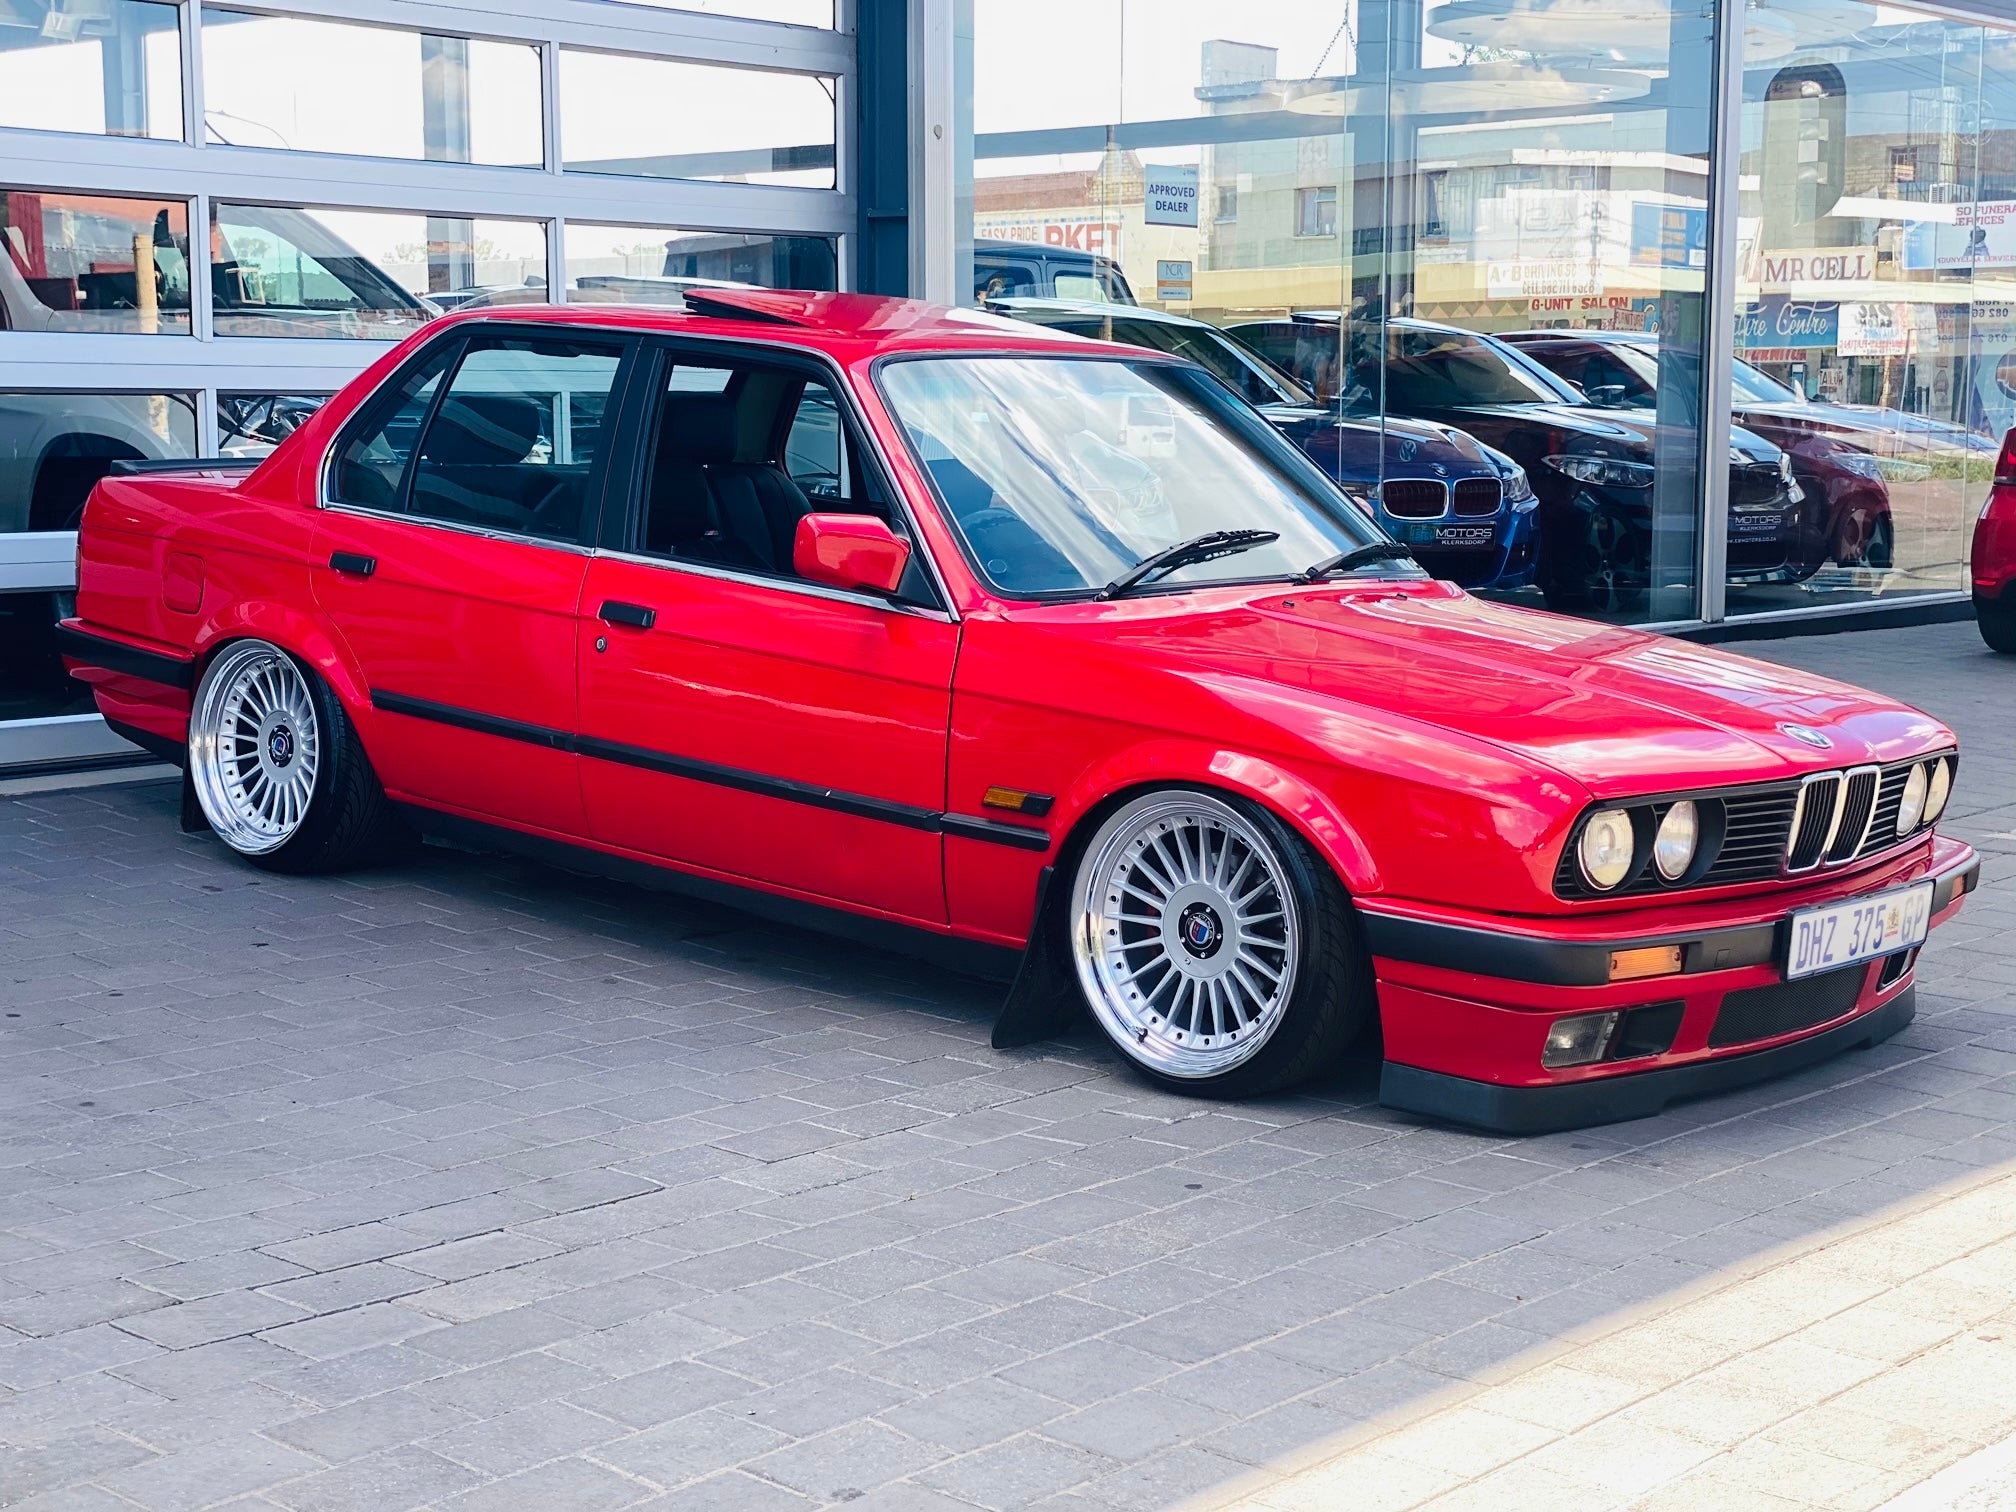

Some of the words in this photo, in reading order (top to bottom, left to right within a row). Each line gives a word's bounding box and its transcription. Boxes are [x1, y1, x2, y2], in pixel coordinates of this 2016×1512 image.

[1148, 184, 1195, 198] APPROVED
[1155, 200, 1189, 213] DEALER
[1165, 263, 1184, 277] NCR
[1764, 258, 1804, 282] MR
[1810, 255, 1871, 280] CELL
[1531, 298, 1574, 311] G-UNIT
[1581, 296, 1629, 310] SALON
[1776, 302, 1839, 336] Centre
[1736, 515, 1781, 524] MOTORS
[1436, 528, 1492, 537] MOTORS
[1795, 915, 1838, 969] DHZ
[1848, 904, 1887, 957] 375
[1901, 894, 1925, 942] GP
